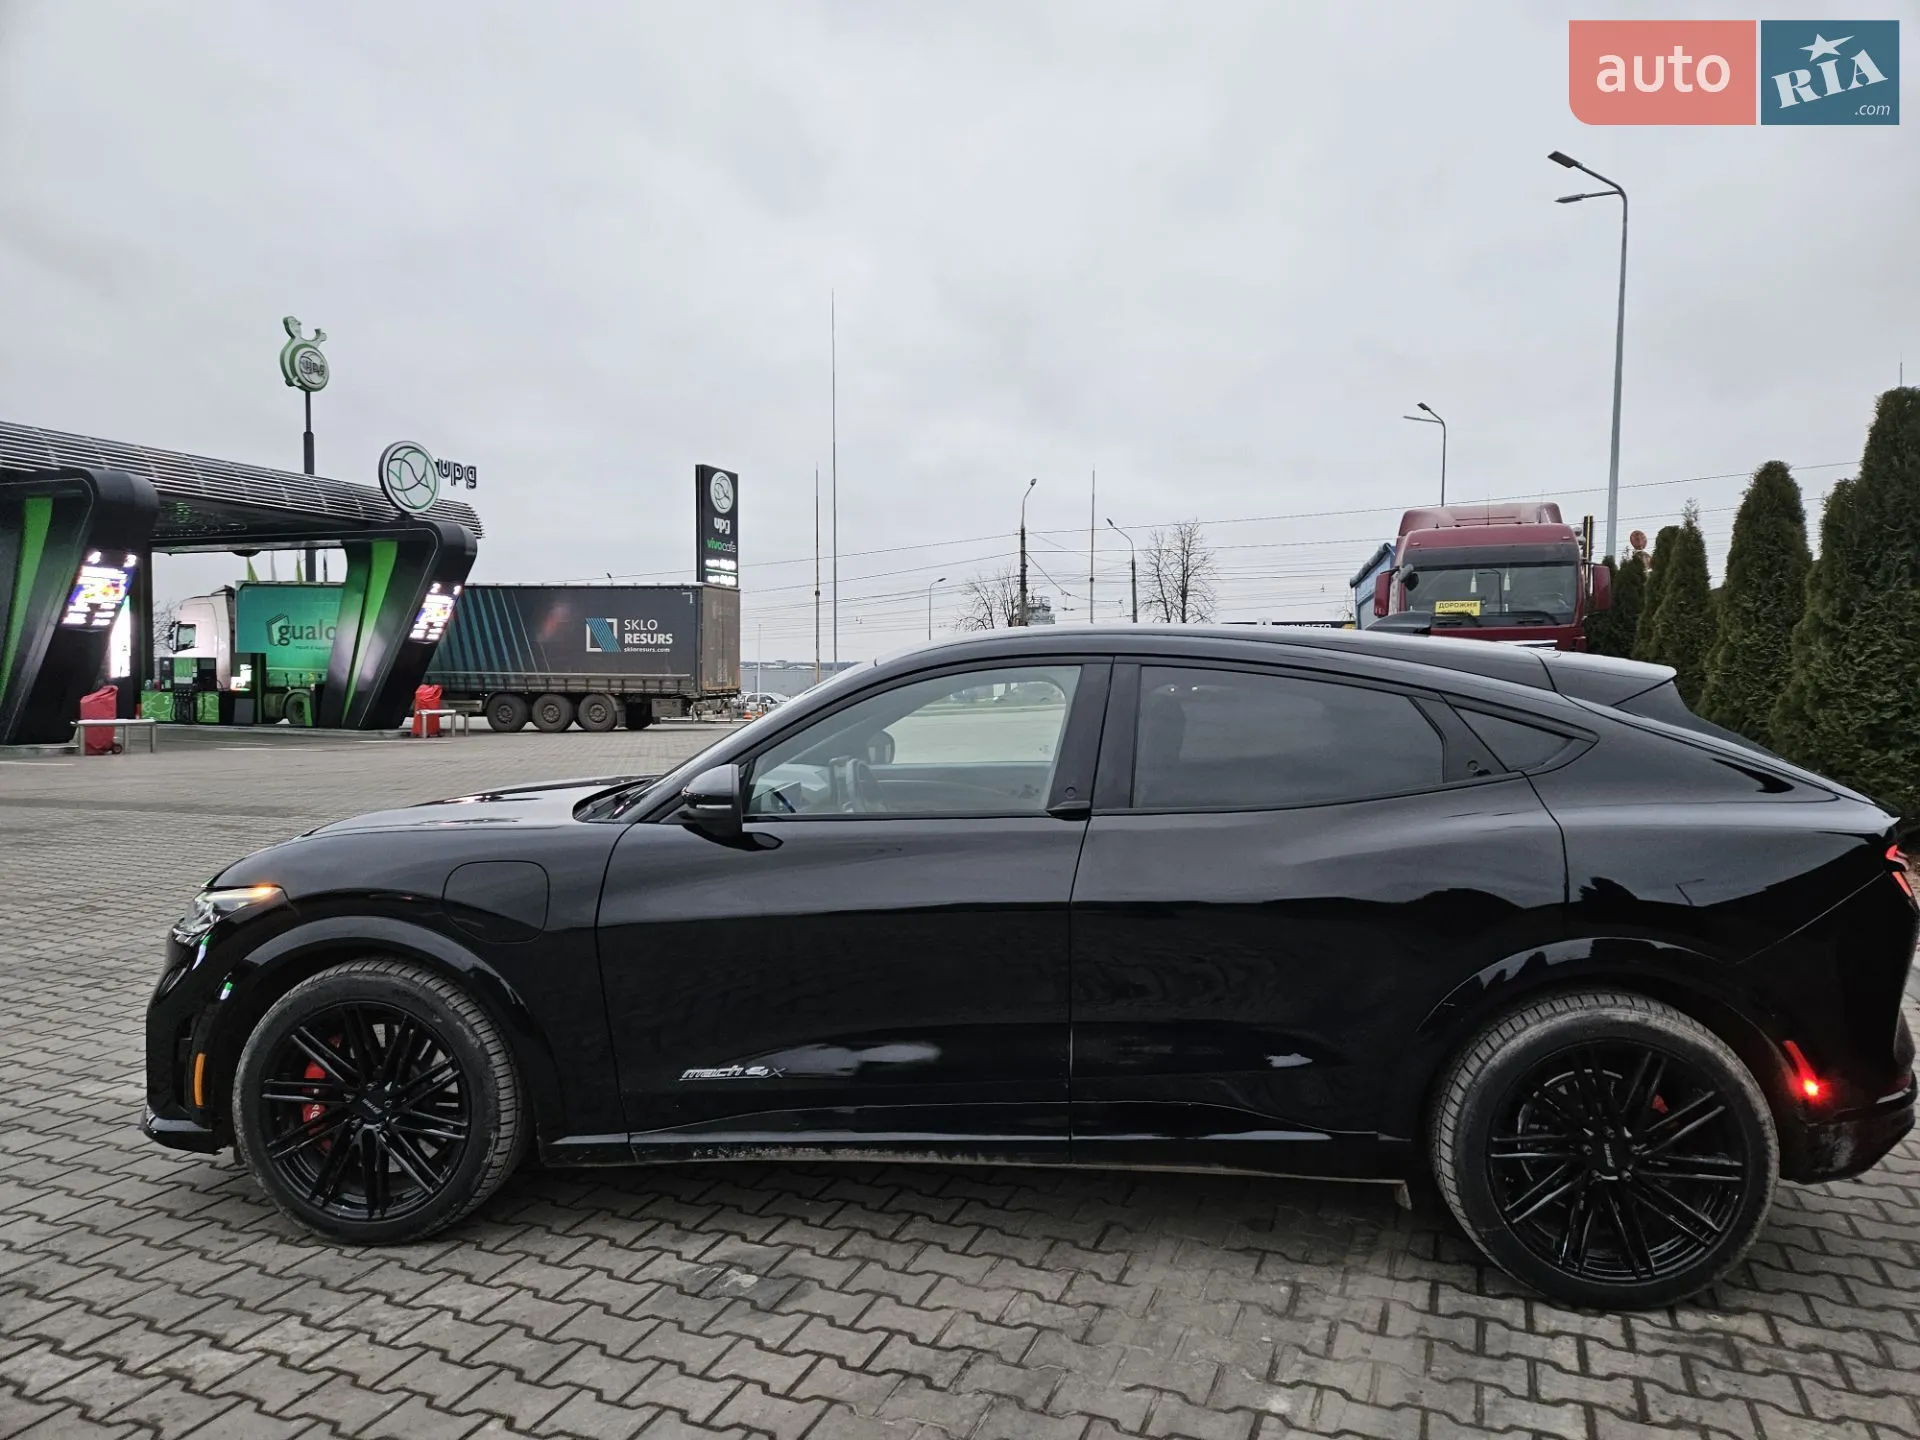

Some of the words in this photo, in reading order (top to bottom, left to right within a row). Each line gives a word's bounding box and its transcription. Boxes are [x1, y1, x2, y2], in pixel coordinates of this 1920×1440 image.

[437, 458, 477, 490] upg
[713, 517, 730, 534] upg
[624, 619, 658, 631] SKLO
[624, 633, 673, 645] RESURS
